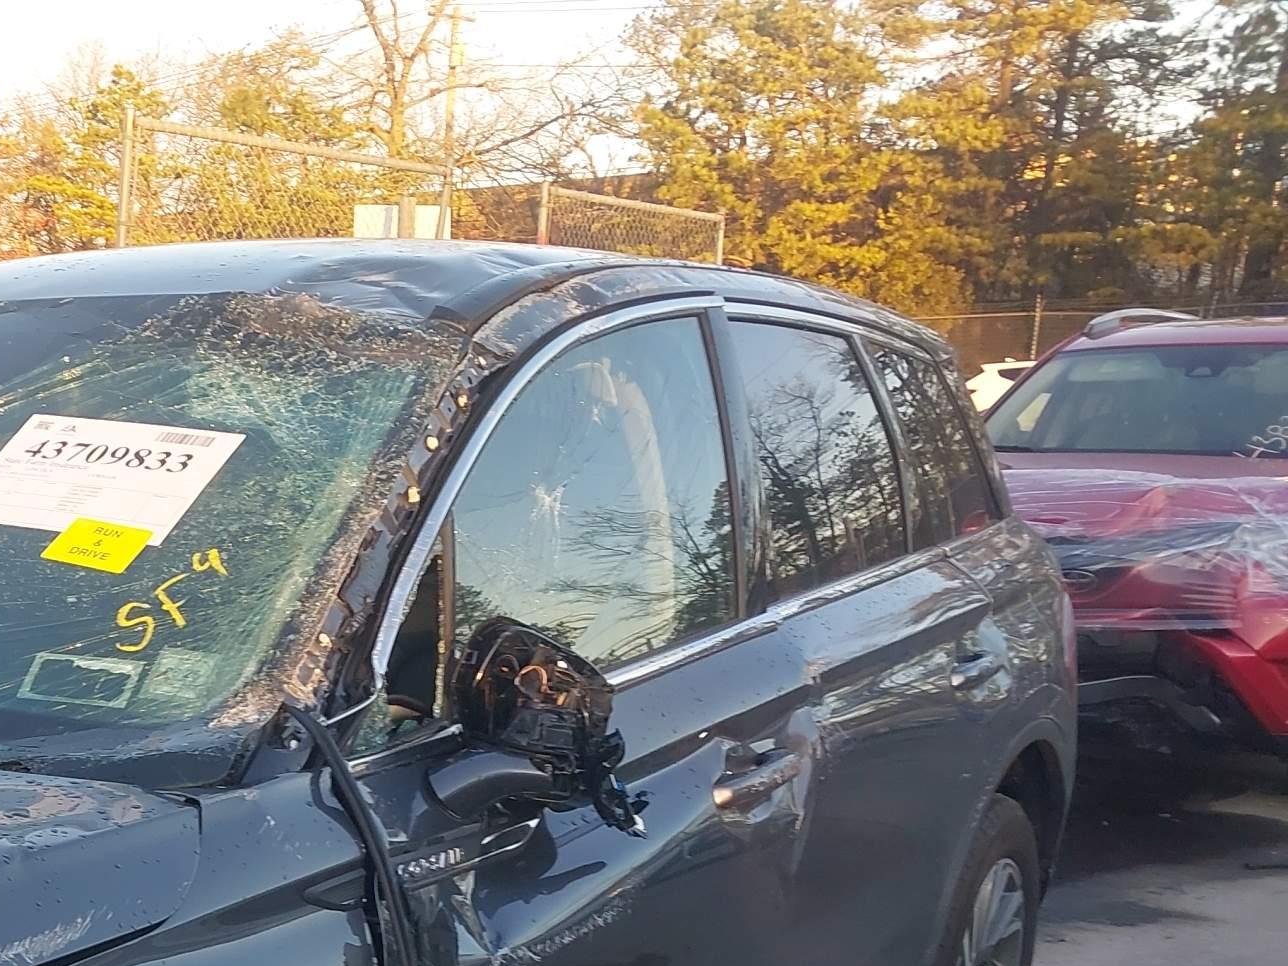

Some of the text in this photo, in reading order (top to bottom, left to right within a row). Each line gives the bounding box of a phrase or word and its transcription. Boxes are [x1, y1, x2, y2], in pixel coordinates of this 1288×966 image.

[24, 439, 194, 473] 43709833
[93, 526, 124, 538] RUN
[68, 546, 112, 561] DRIVE
